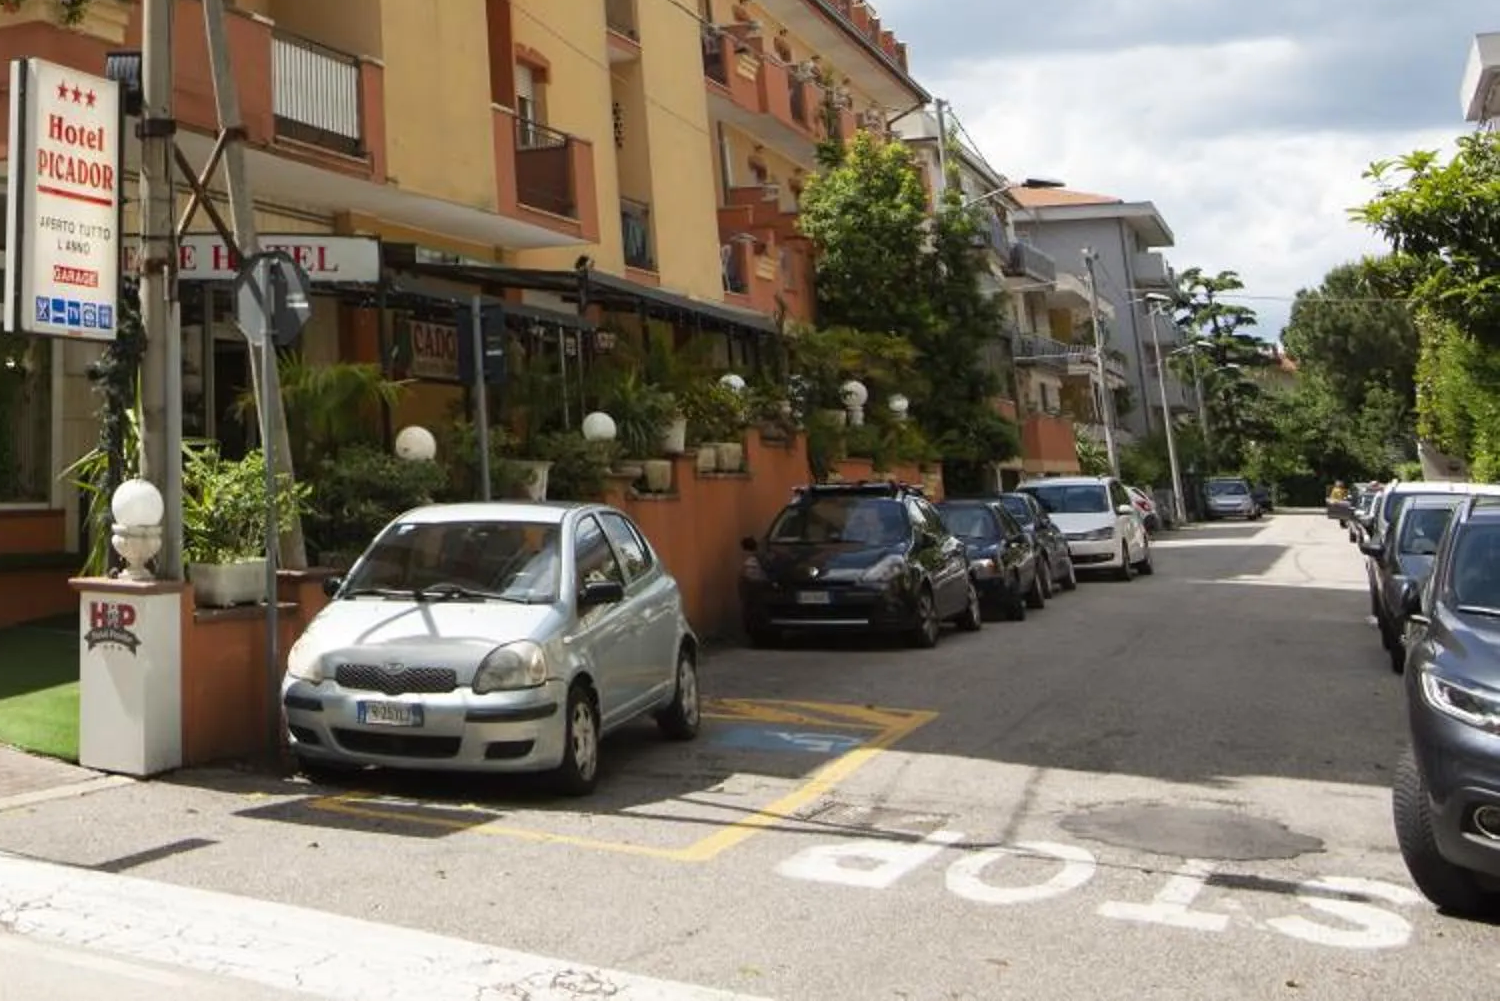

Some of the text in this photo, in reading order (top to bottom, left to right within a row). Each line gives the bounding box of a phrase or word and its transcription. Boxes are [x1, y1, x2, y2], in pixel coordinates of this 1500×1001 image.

[49, 113, 104, 152] Hotel
[37, 149, 113, 191] PICADOR
[80, 224, 111, 241] TUTTO
[774, 830, 1422, 949] STOP
